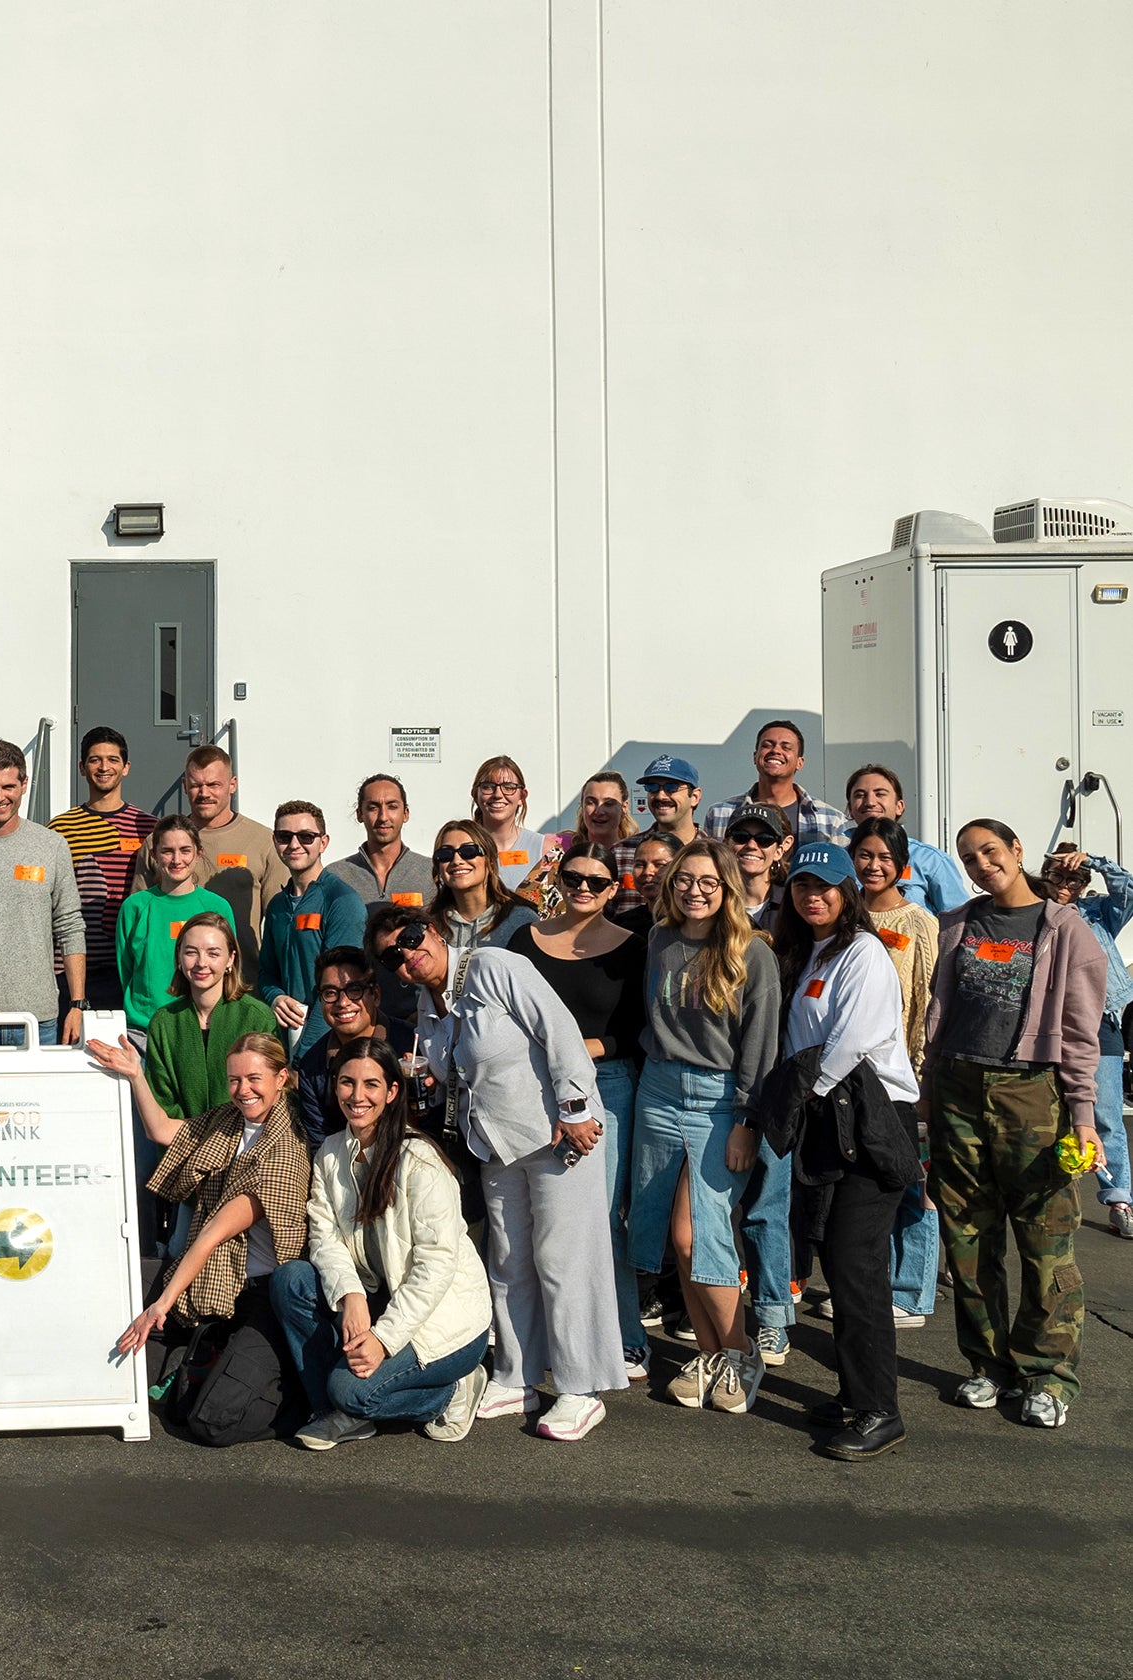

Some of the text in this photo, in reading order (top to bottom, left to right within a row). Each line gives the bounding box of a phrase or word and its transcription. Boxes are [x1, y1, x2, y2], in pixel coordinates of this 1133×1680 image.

[741, 807, 768, 818] RAILS
[798, 851, 829, 864] RAILS
[446, 1076, 458, 1125] MICHAEL
